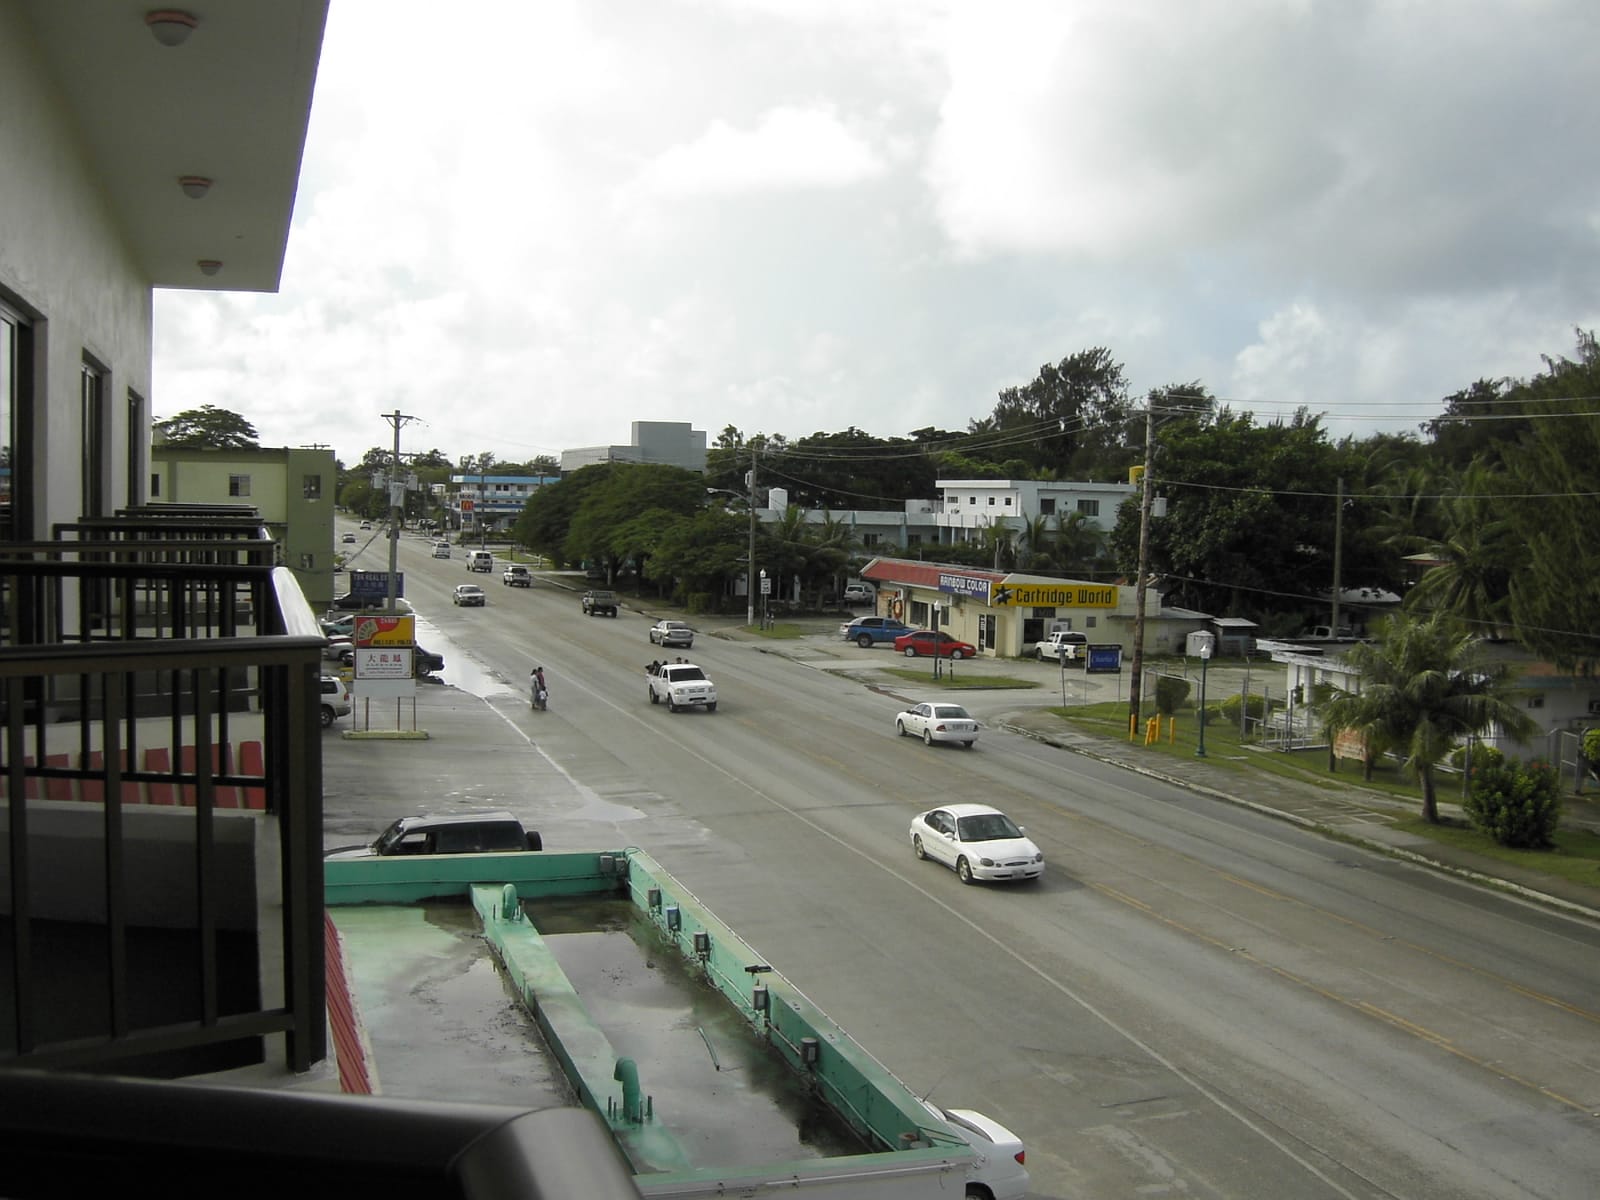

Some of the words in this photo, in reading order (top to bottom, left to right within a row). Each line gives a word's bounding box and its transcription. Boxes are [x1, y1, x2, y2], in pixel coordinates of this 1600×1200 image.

[940, 575, 966, 589] RAINBOW
[966, 579, 987, 593] COLOR
[1016, 588, 1073, 606] Cartridge
[1078, 588, 1113, 604] World
